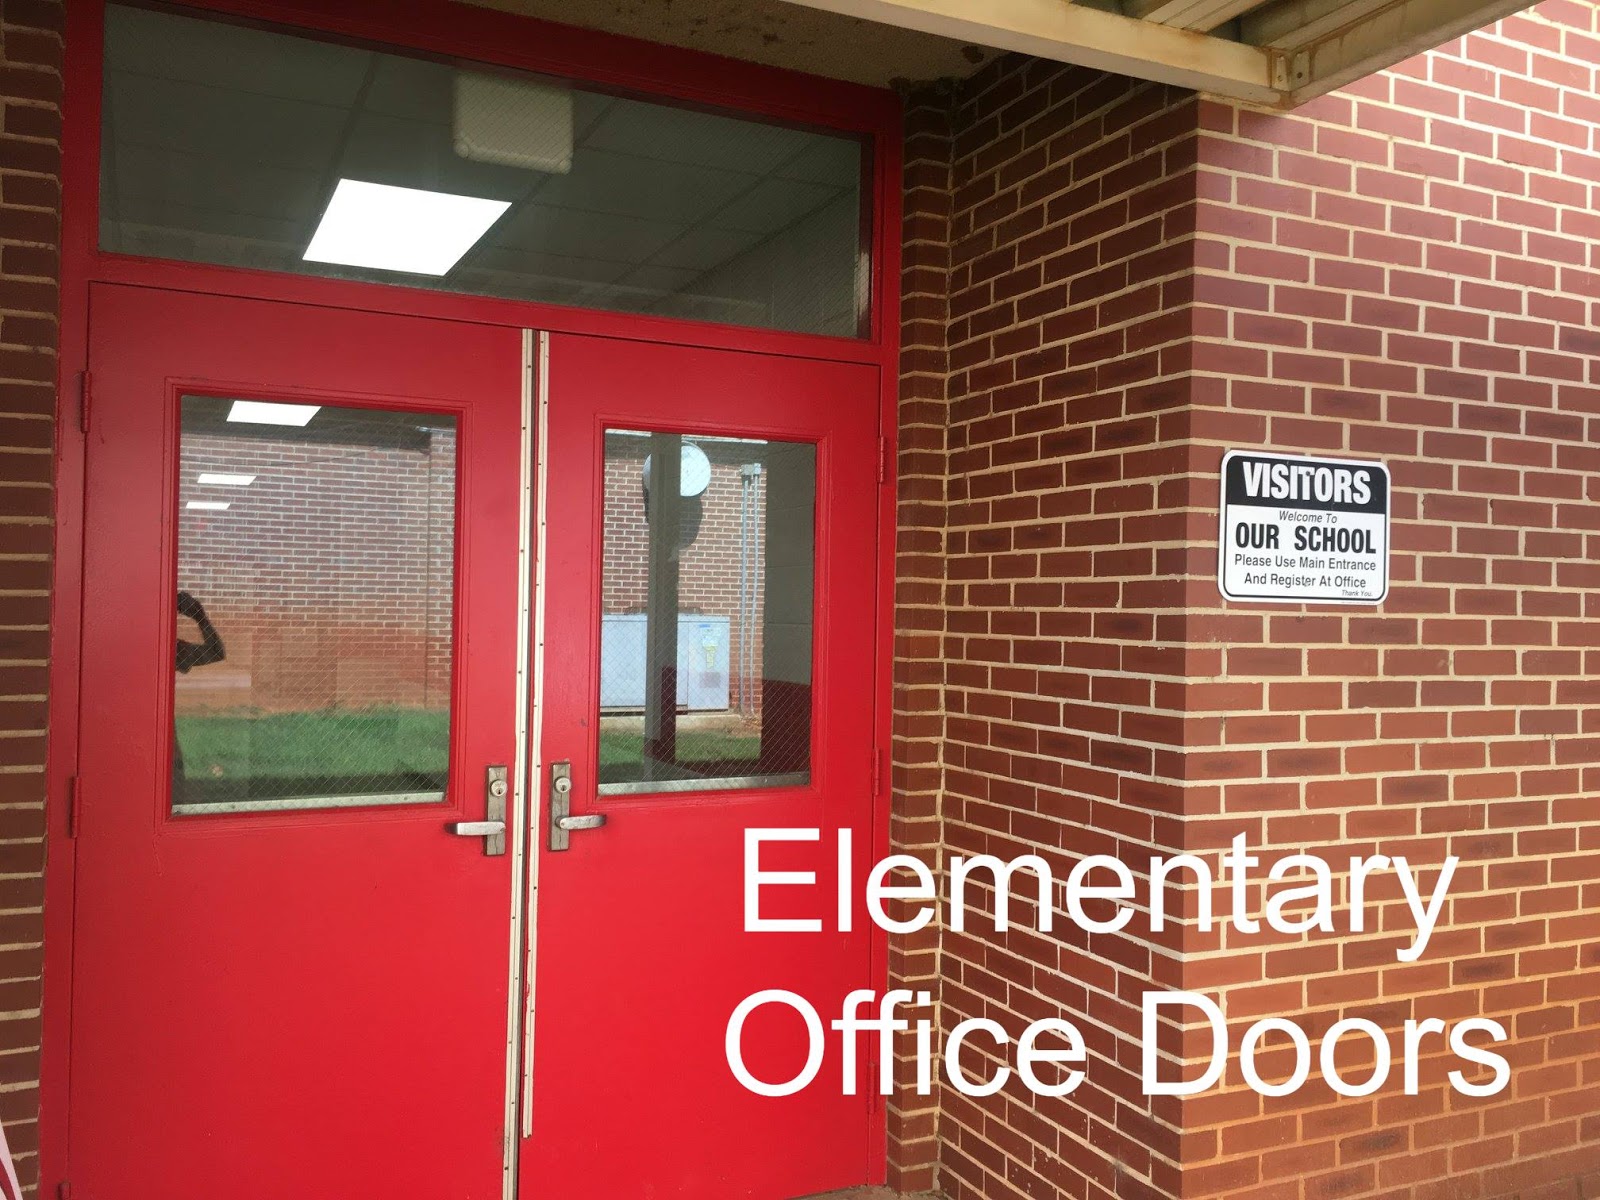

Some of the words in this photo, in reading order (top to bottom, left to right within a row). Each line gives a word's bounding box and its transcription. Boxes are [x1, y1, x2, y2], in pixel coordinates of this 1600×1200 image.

[1242, 461, 1372, 505] VISITORS
[1279, 510, 1323, 523] Welcome
[1326, 513, 1338, 524] To
[1235, 522, 1280, 550] OUR
[1294, 525, 1377, 555] SCHOOL
[1234, 554, 1272, 567] Please
[1275, 555, 1296, 568] Use
[1299, 556, 1325, 569] Main
[1328, 558, 1377, 571] Entrance
[1244, 572, 1267, 585] And
[1270, 573, 1316, 588] Register
[1319, 575, 1332, 587] At
[1334, 576, 1367, 588] Office
[1341, 589, 1359, 597] Thank
